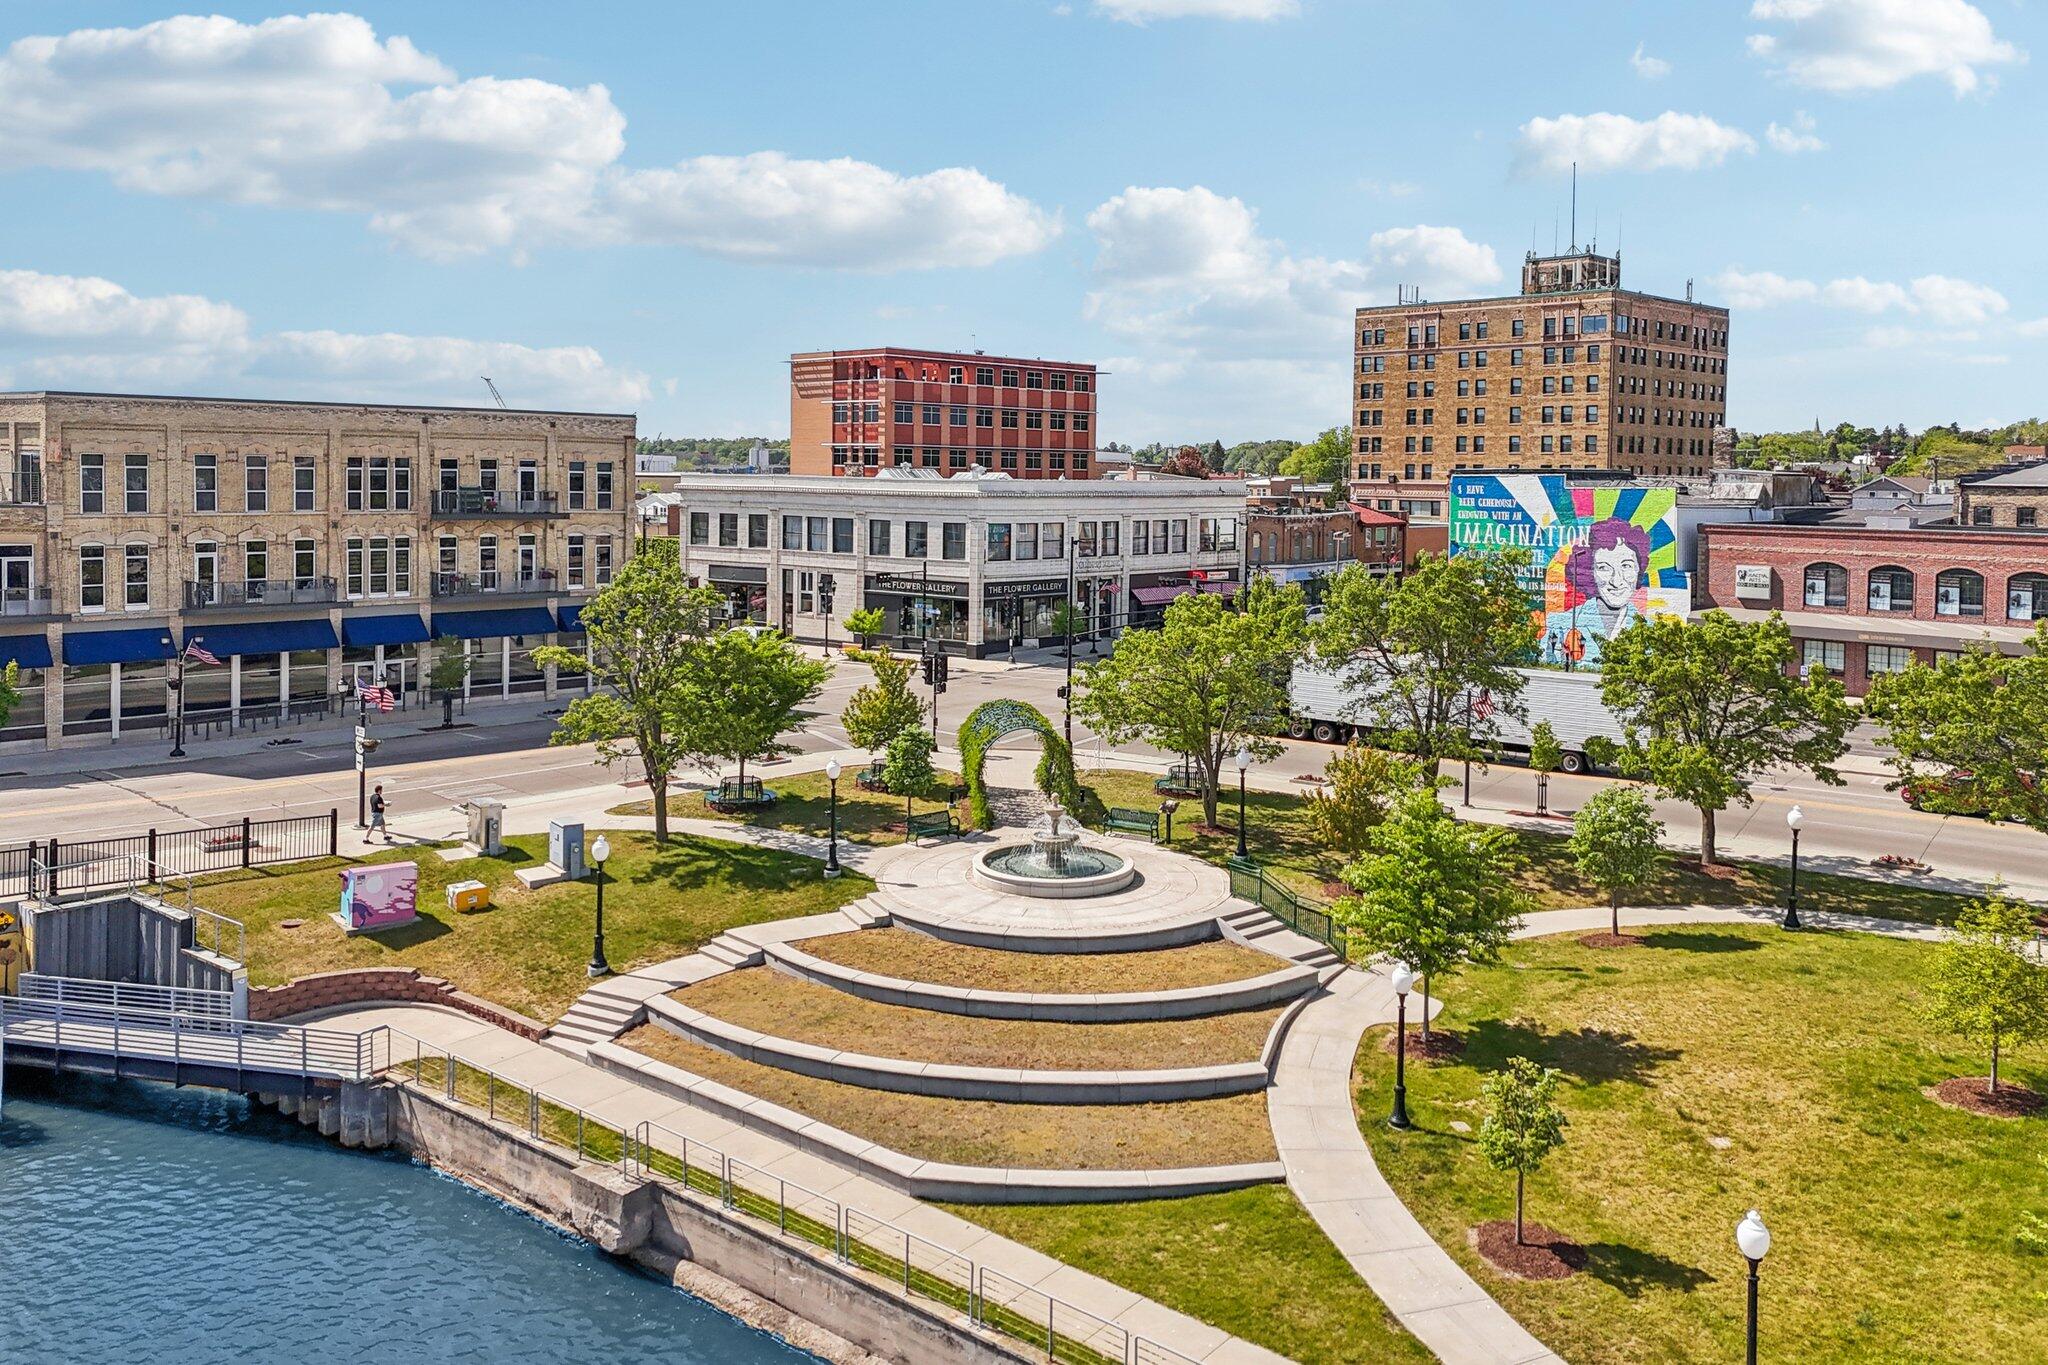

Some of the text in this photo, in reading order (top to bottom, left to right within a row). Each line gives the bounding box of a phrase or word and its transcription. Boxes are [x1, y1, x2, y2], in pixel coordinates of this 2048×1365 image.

[1466, 485, 1485, 494] HAVE
[1459, 497, 1517, 508] BEEN GENEROUSLY
[1457, 510, 1522, 520] ENDOWED WITH AN
[1454, 521, 1591, 548] IMAGINATION
[892, 581, 921, 590] FLOWER
[988, 582, 1062, 594] THE FLOWER GALLERY
